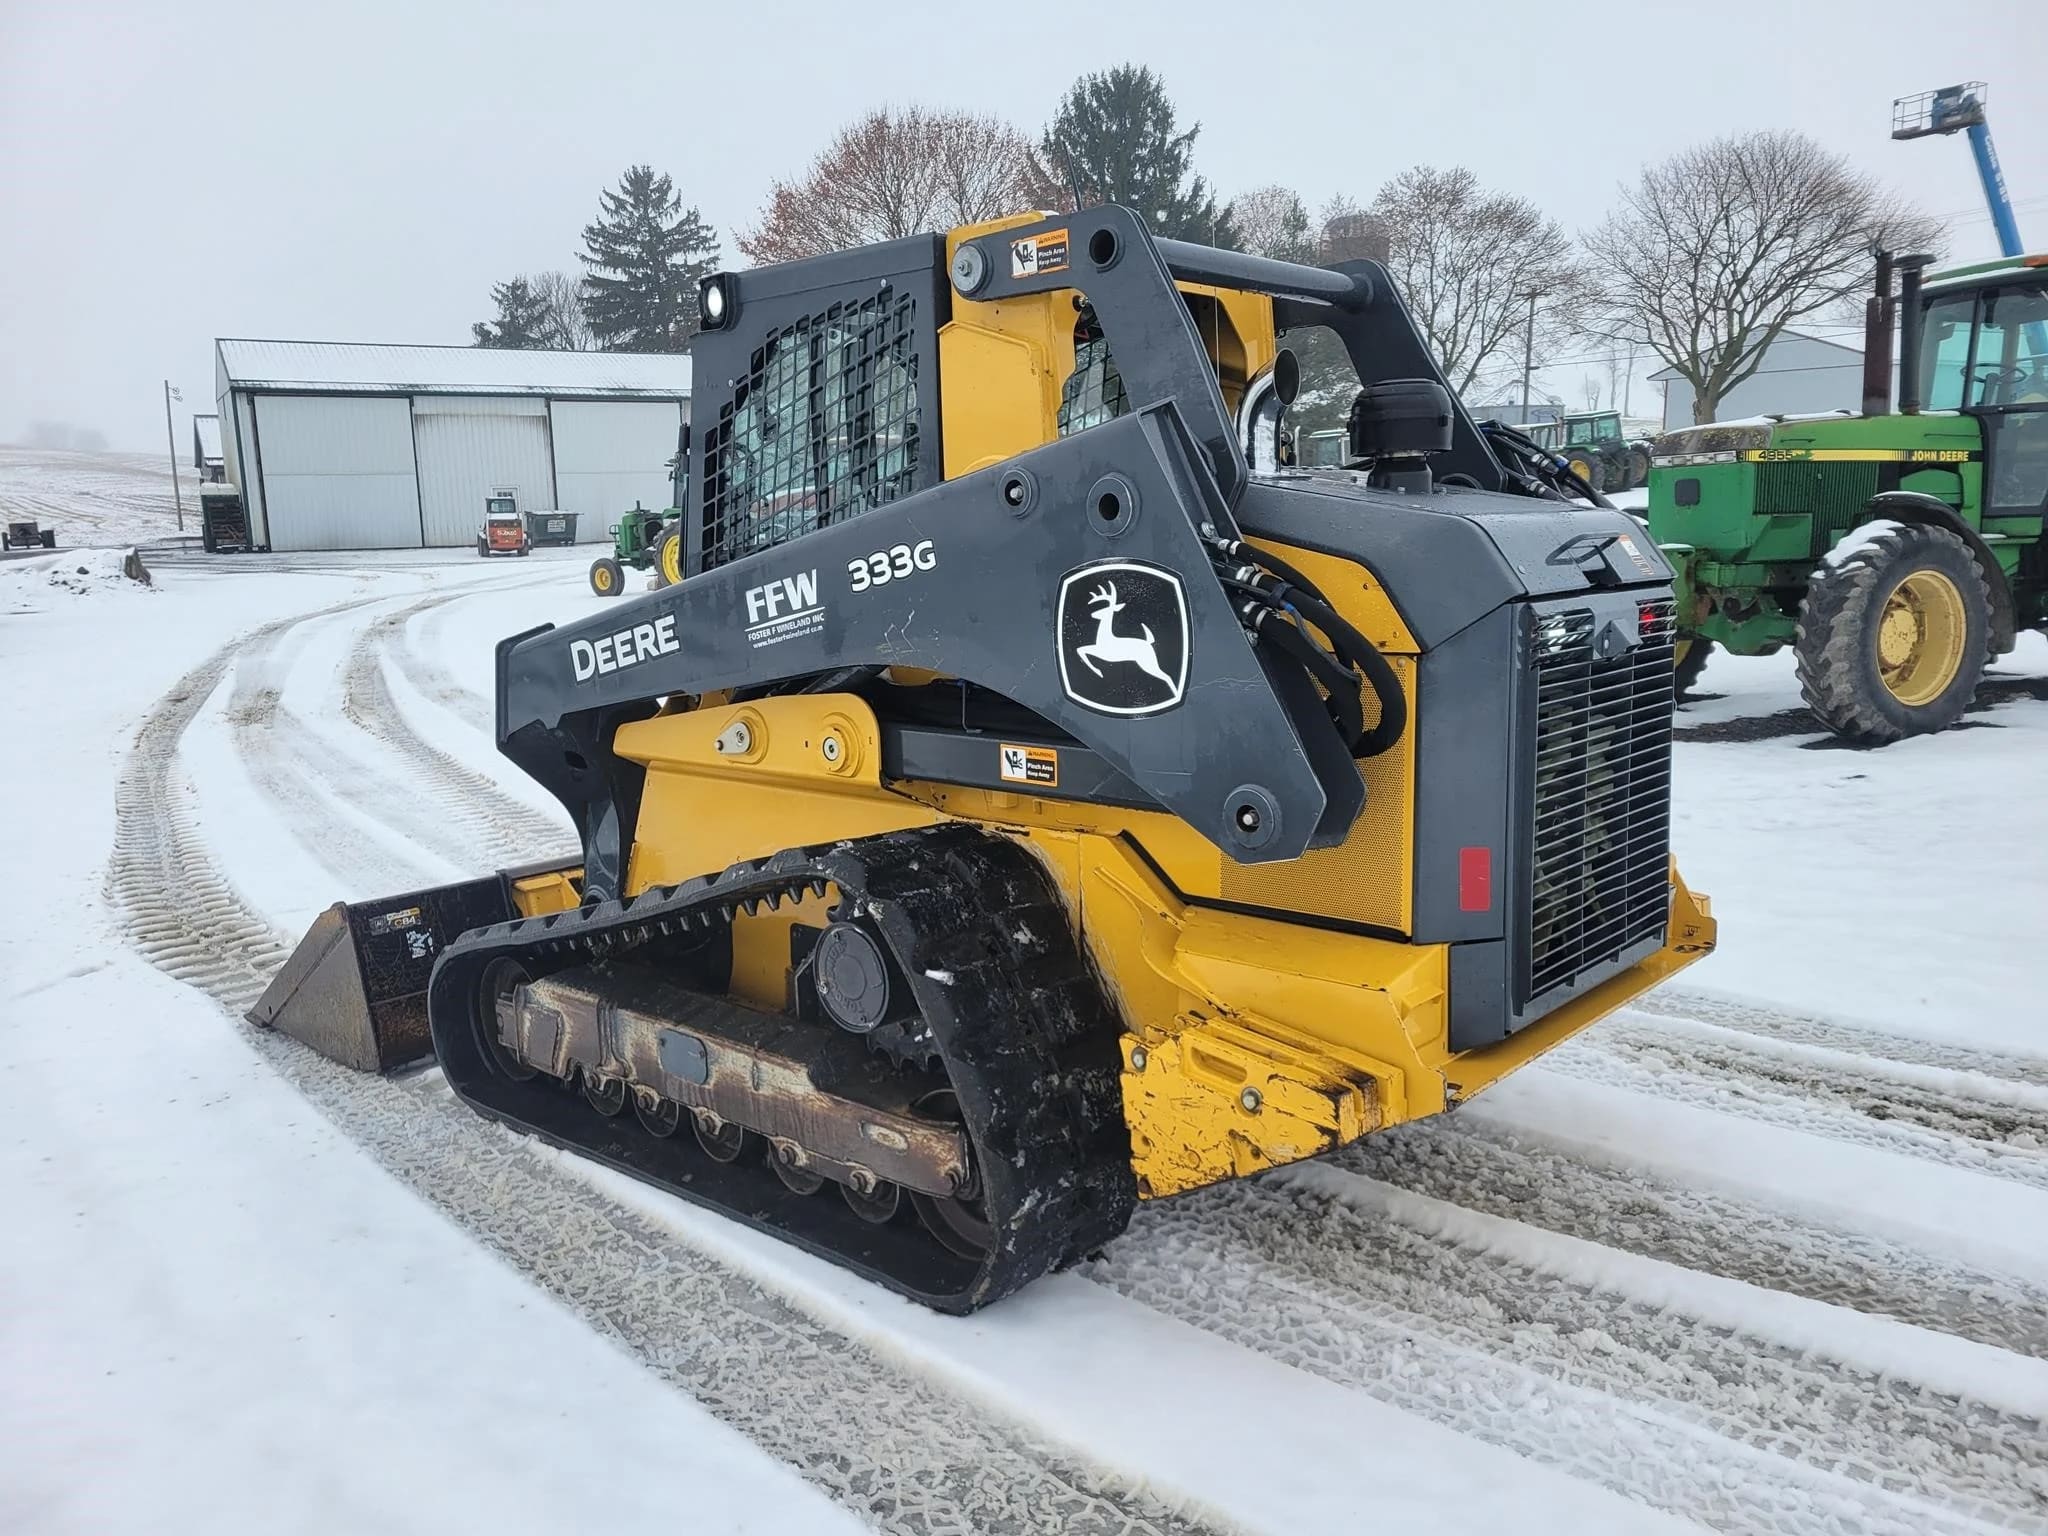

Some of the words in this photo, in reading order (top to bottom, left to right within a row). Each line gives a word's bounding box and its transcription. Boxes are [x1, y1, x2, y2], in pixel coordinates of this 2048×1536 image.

[1758, 450, 1793, 460] 4955
[1912, 451, 1937, 461] JOHN
[1940, 451, 1969, 461] DEERE
[847, 540, 937, 592] 333G
[745, 568, 818, 624] FFW
[748, 628, 772, 641] FOSTER
[771, 627, 777, 636] F
[777, 617, 811, 634] WINELAND
[812, 612, 825, 624] INC
[569, 614, 680, 682] DEERE
[1027, 762, 1041, 770] Pinch
[1042, 764, 1053, 772] Area
